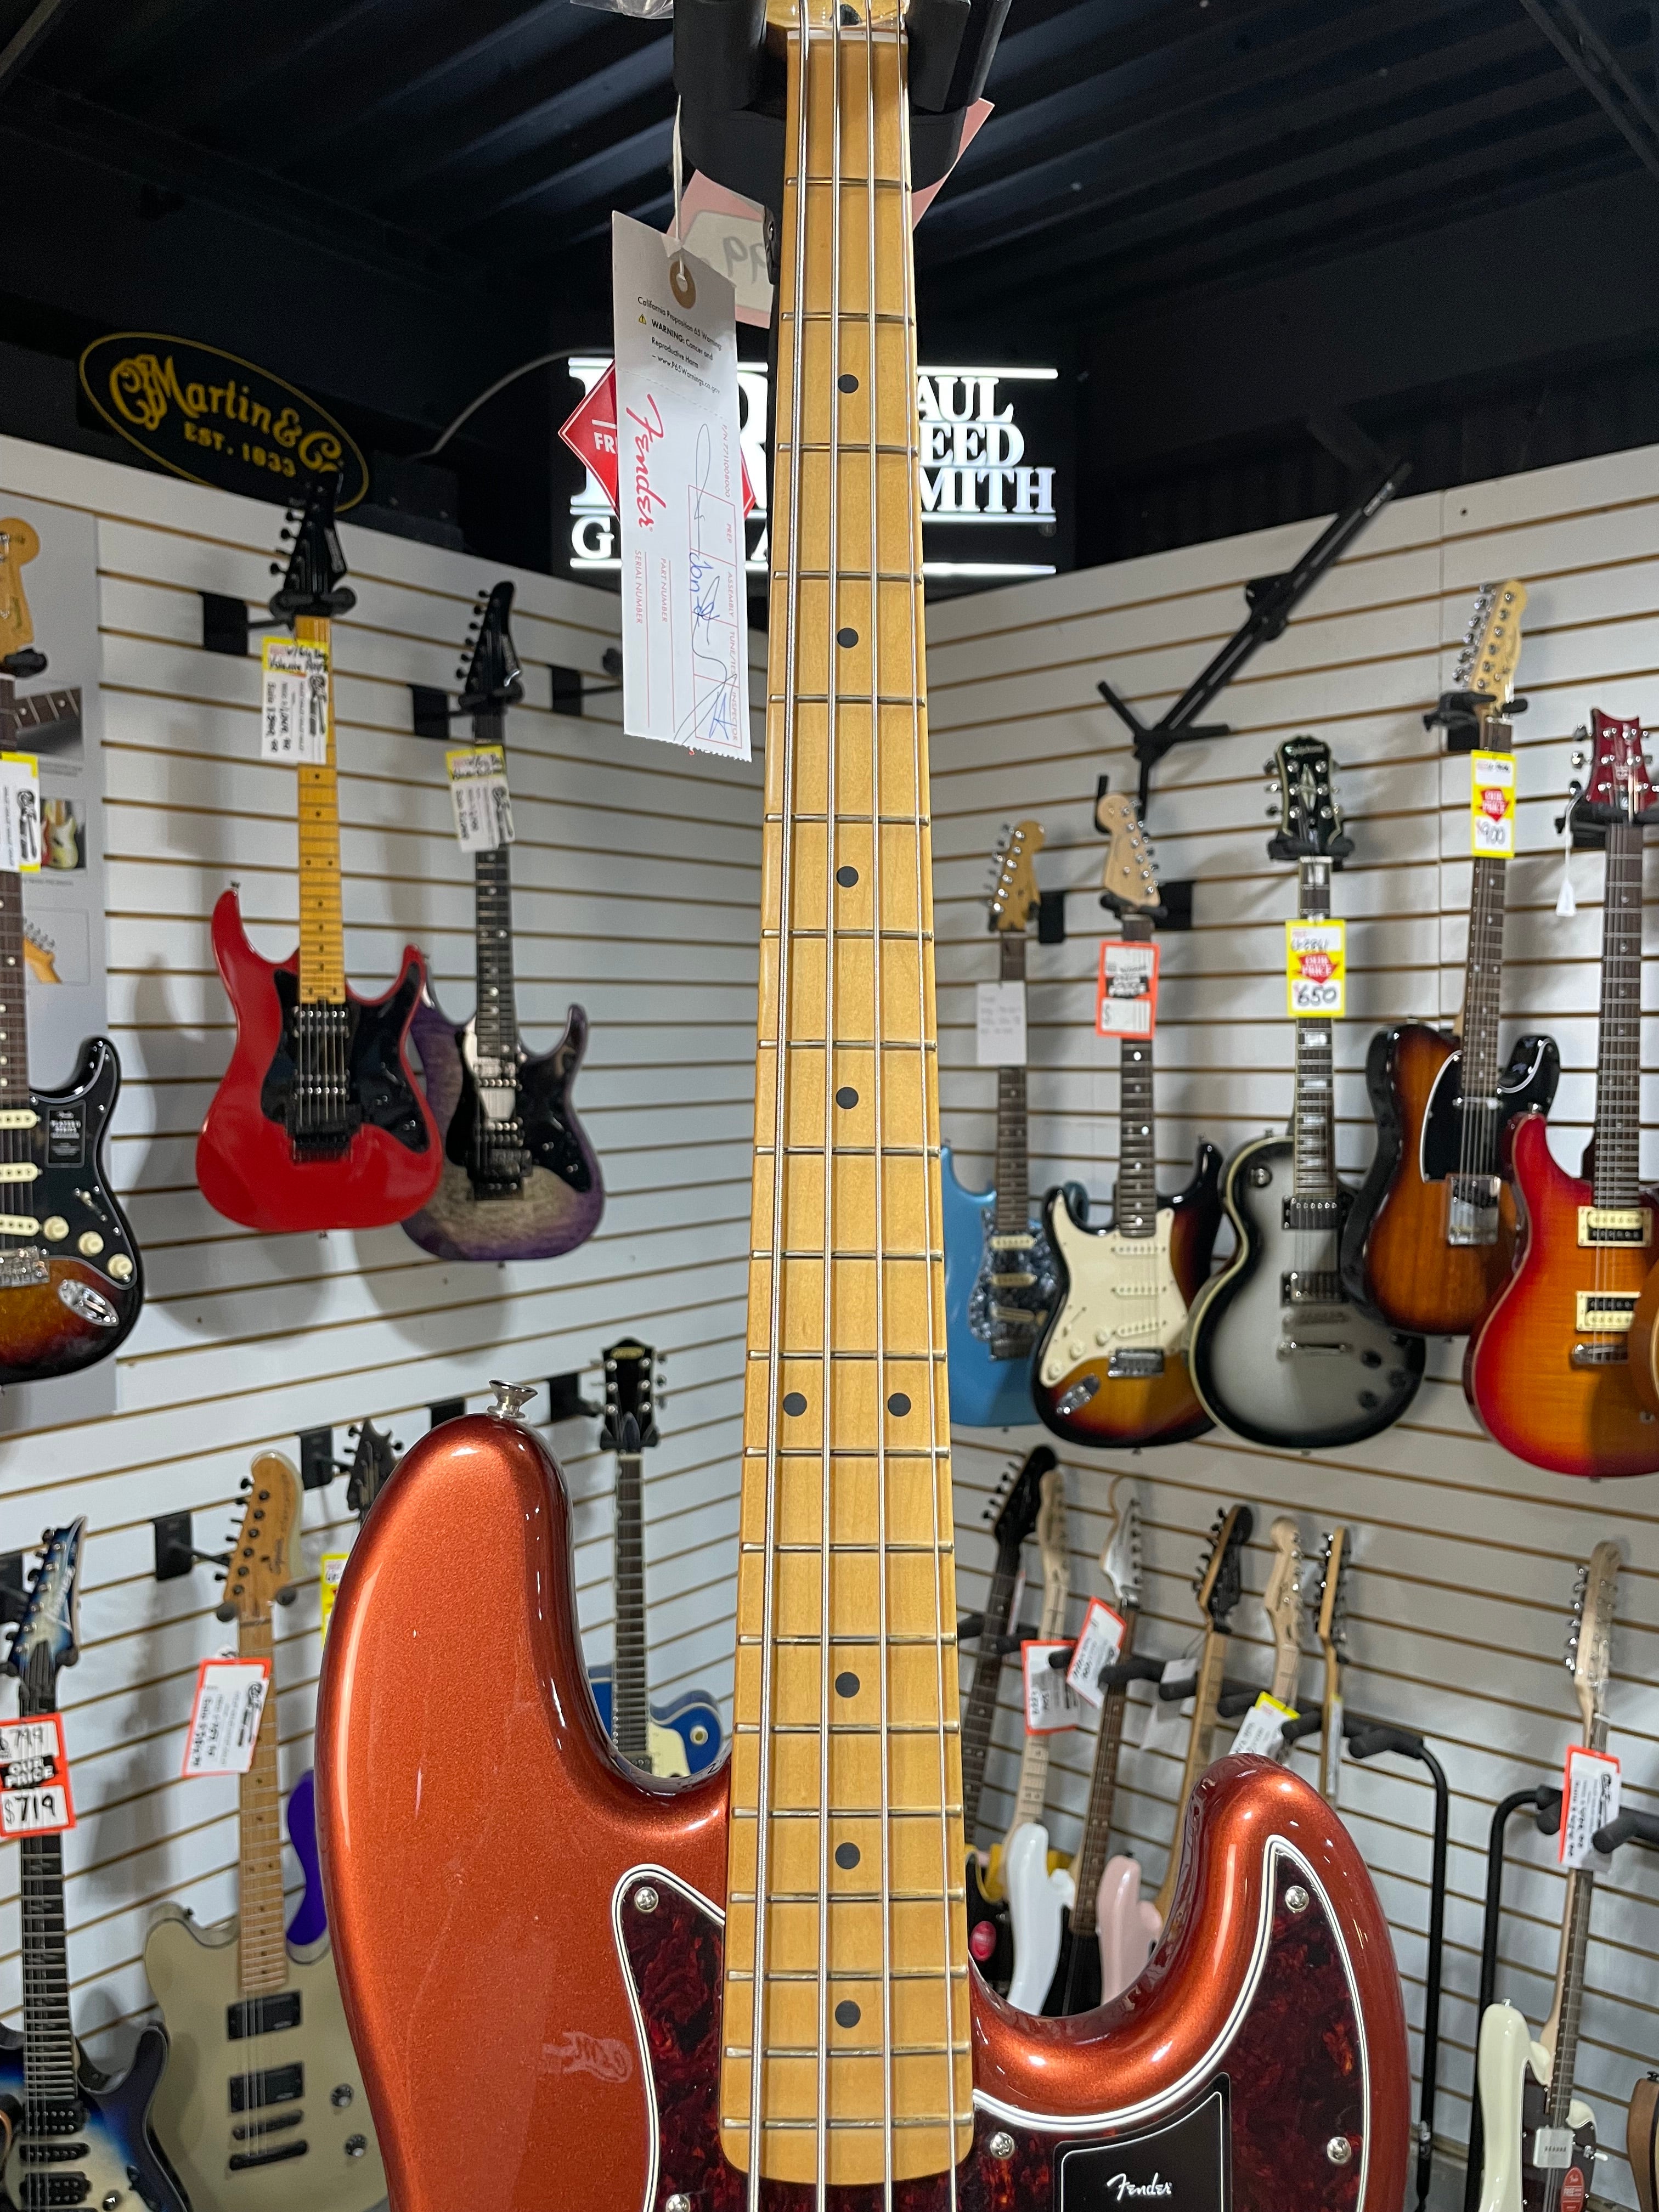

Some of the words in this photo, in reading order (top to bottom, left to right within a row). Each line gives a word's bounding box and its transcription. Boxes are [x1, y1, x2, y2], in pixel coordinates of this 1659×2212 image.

[637, 296, 665, 315] California
[667, 311, 693, 332] Proposition
[694, 328, 701, 336] 65
[652, 319, 685, 343] WARNING:
[686, 338, 703, 354] Cancer
[704, 349, 713, 360] and
[652, 337, 685, 360] Reproductive
[685, 356, 698, 369] Harm
[917, 376, 1014, 423] AUL
[184, 421, 234, 456] EST.
[919, 422, 1024, 467] EED
[626, 393, 667, 528] Fender
[919, 467, 1056, 514] MITH
[4, 1795, 55, 1825] $719
[1107, 2172, 1172, 2201] Fender
